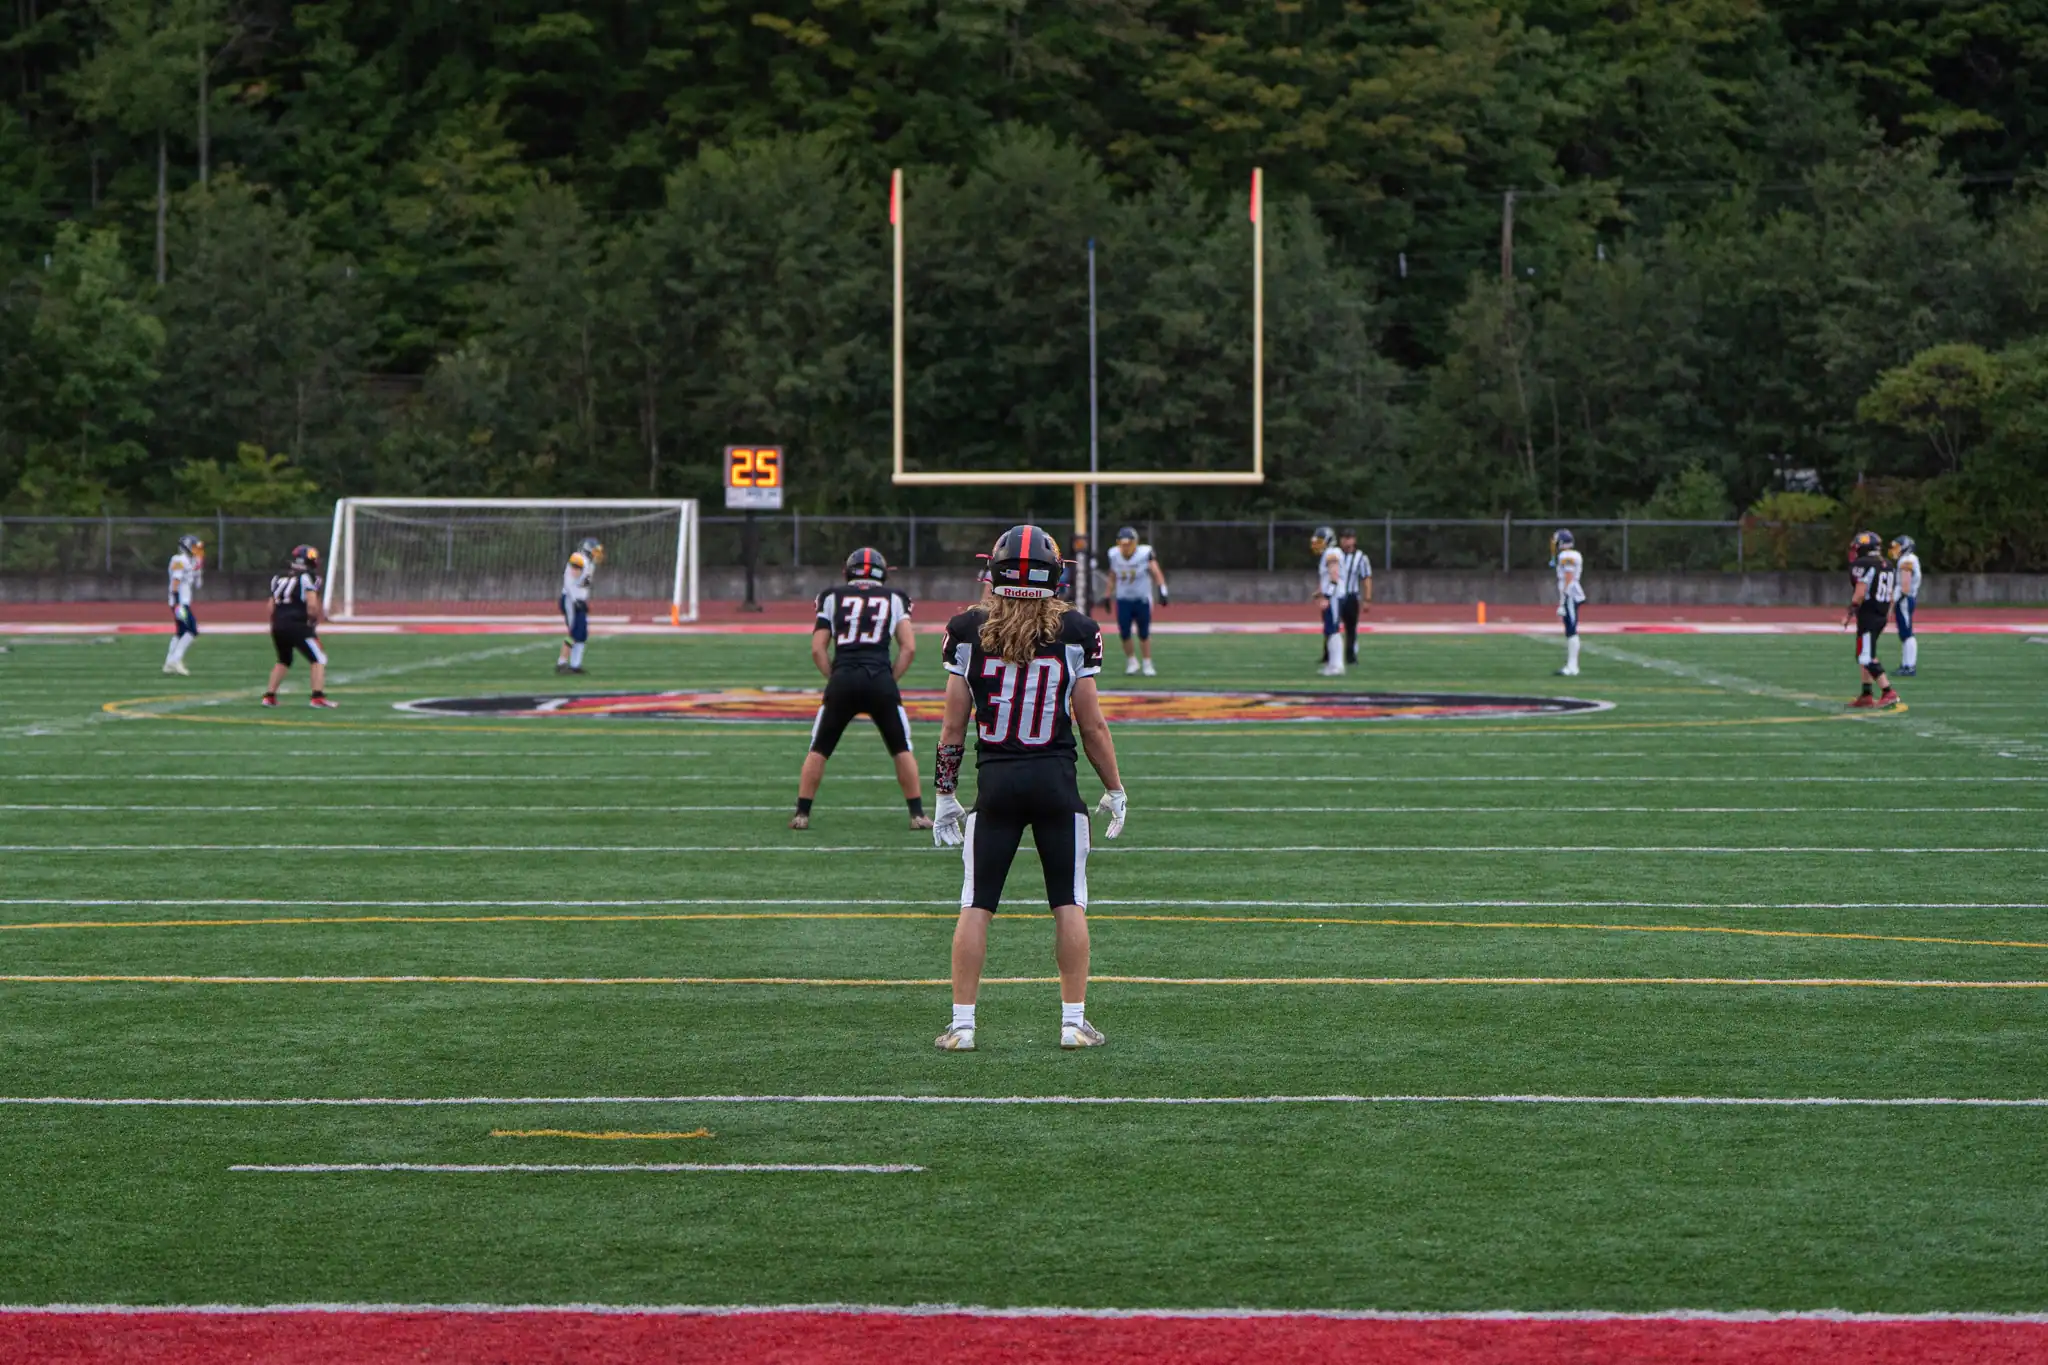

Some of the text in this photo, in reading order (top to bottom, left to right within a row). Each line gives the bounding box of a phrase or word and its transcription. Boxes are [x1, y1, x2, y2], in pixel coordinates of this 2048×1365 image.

[731, 449, 777, 487] 25
[1004, 588, 1042, 598] Riddell
[837, 596, 890, 645] 33
[979, 656, 1064, 747] 30
